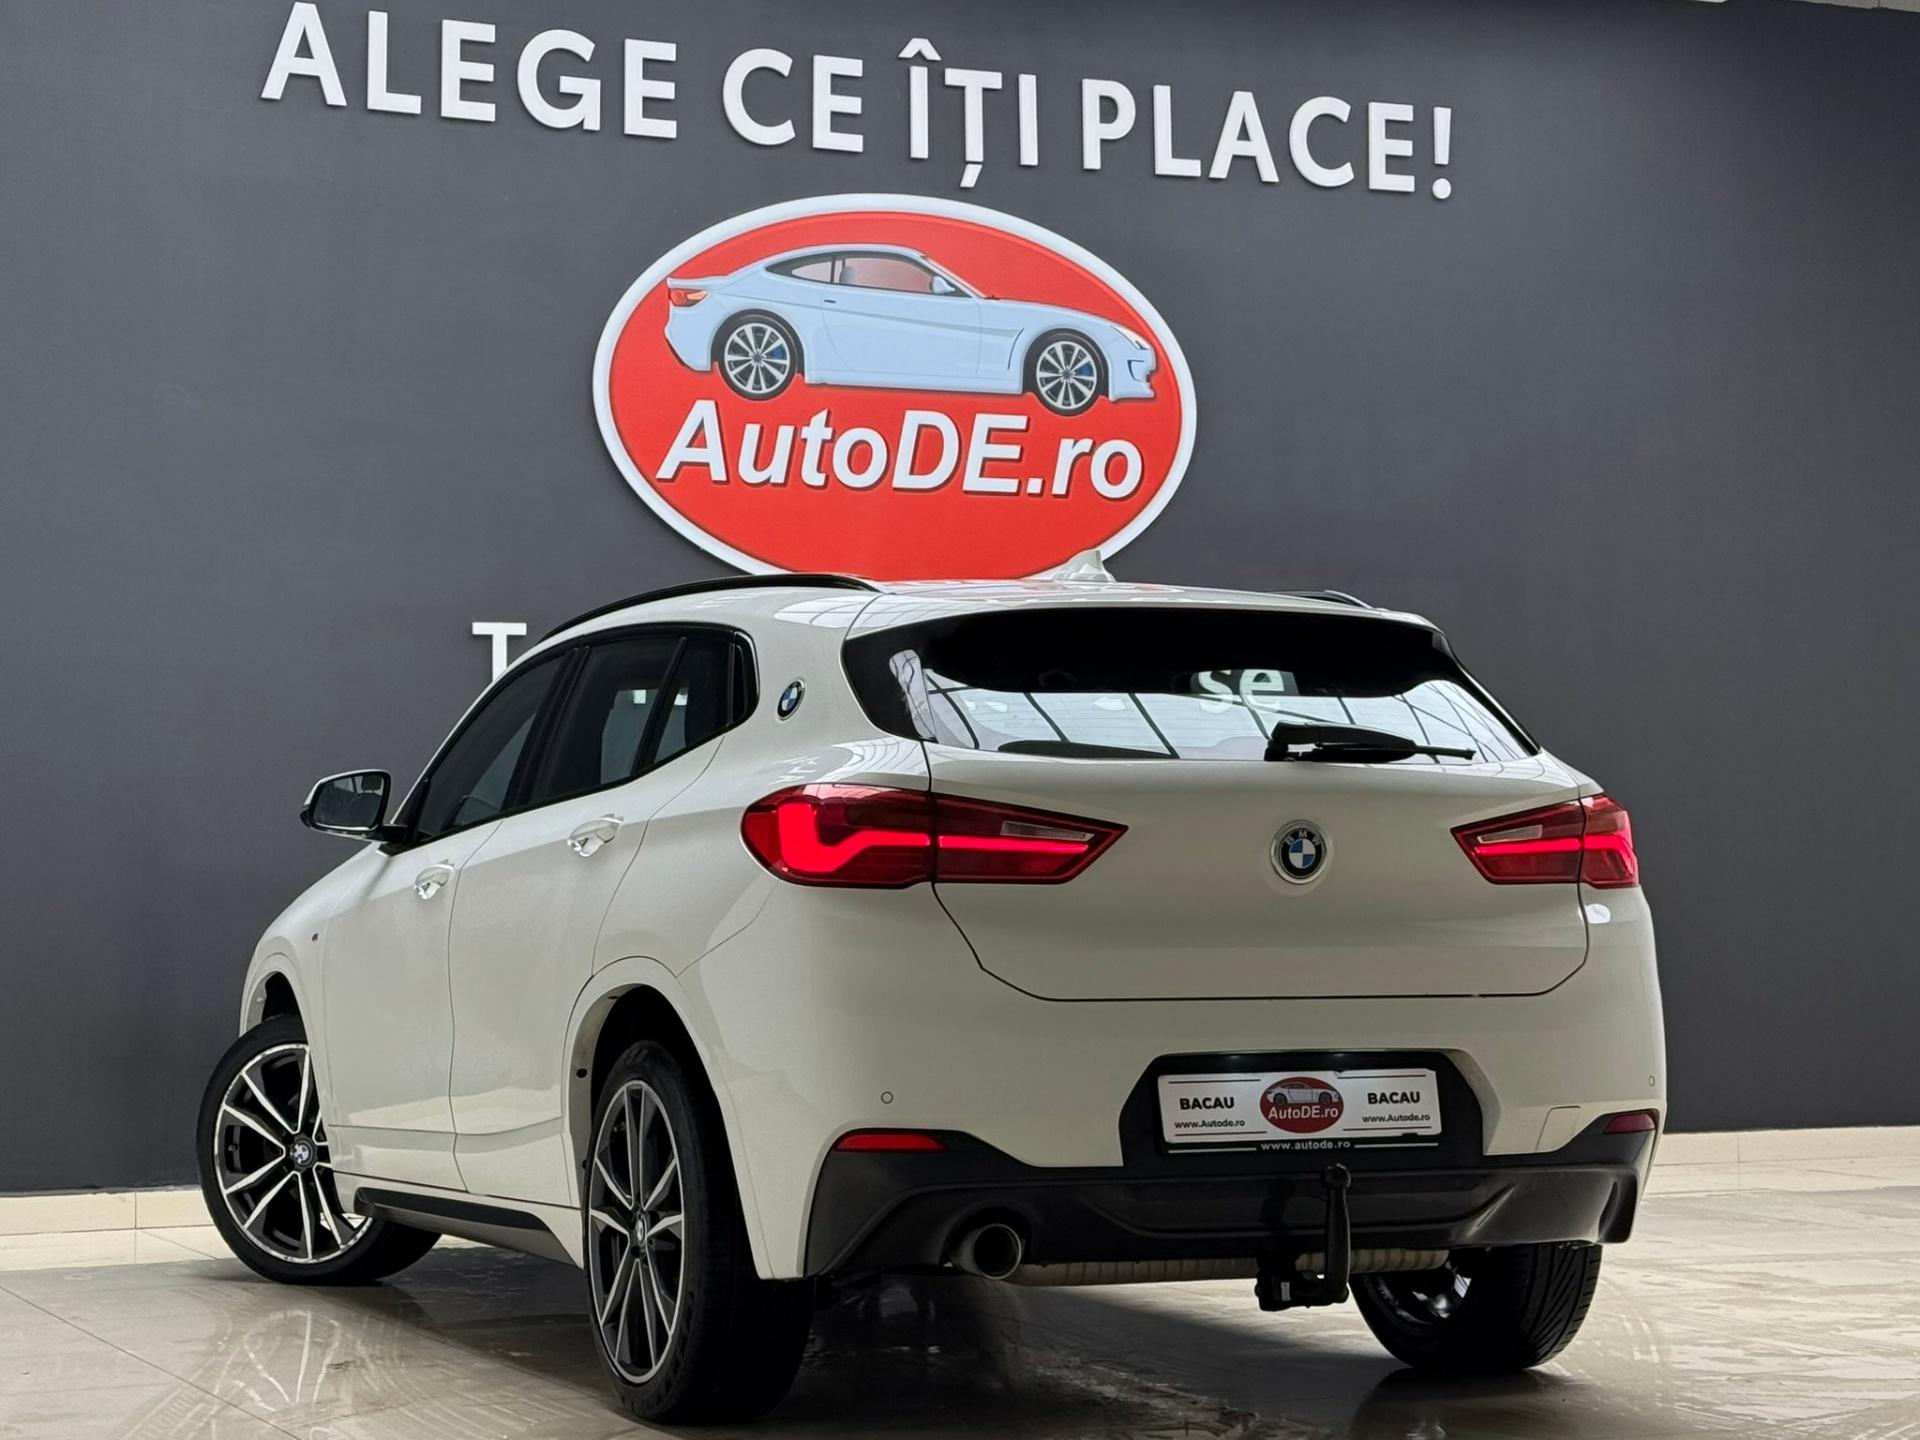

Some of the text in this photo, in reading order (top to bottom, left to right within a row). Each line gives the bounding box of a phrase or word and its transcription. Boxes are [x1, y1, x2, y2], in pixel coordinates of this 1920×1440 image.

[261, 1, 677, 138] ALEGE
[722, 48, 863, 152] CE
[1082, 78, 1452, 200] PLACE!
[656, 399, 1143, 500] AutoDE.ro
[1180, 1096, 1235, 1110] BACAU
[1367, 1091, 1420, 1104] BACAU
[1268, 1105, 1339, 1120] AutoDE.ro
[1362, 1113, 1431, 1123] www.Autode.ro
[1174, 1119, 1245, 1129] www.Autode.ro
[1260, 1139, 1351, 1151] www.autode.ro
